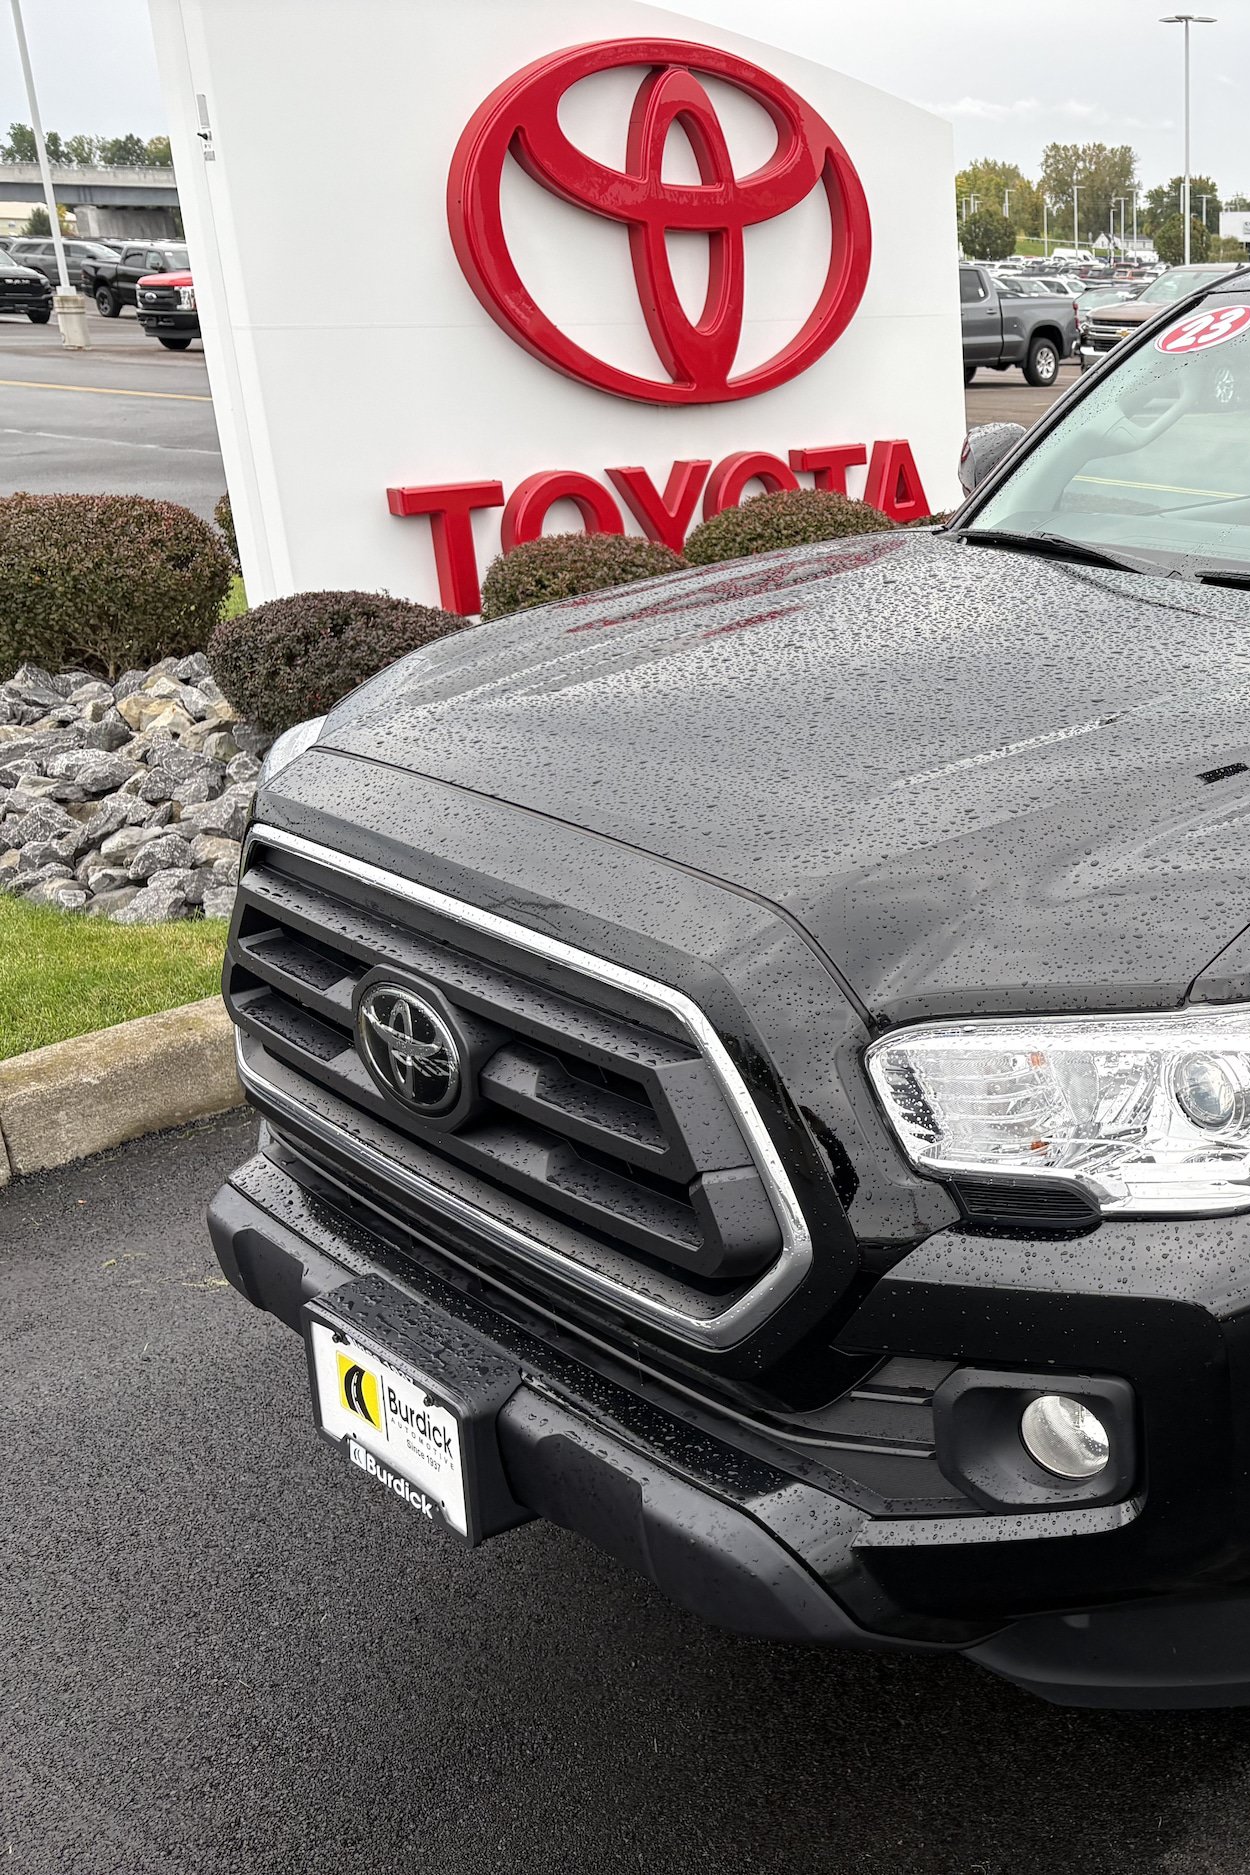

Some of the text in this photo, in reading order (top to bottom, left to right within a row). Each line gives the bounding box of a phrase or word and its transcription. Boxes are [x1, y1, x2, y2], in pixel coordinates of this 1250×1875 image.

[1165, 307, 1246, 351] 23
[386, 439, 932, 617] TOYOTA
[387, 1385, 453, 1460] Burdick
[390, 1416, 455, 1472] AUTOMOTIVE
[366, 1452, 434, 1520] Burdick
[406, 1438, 441, 1473] Since 1937
